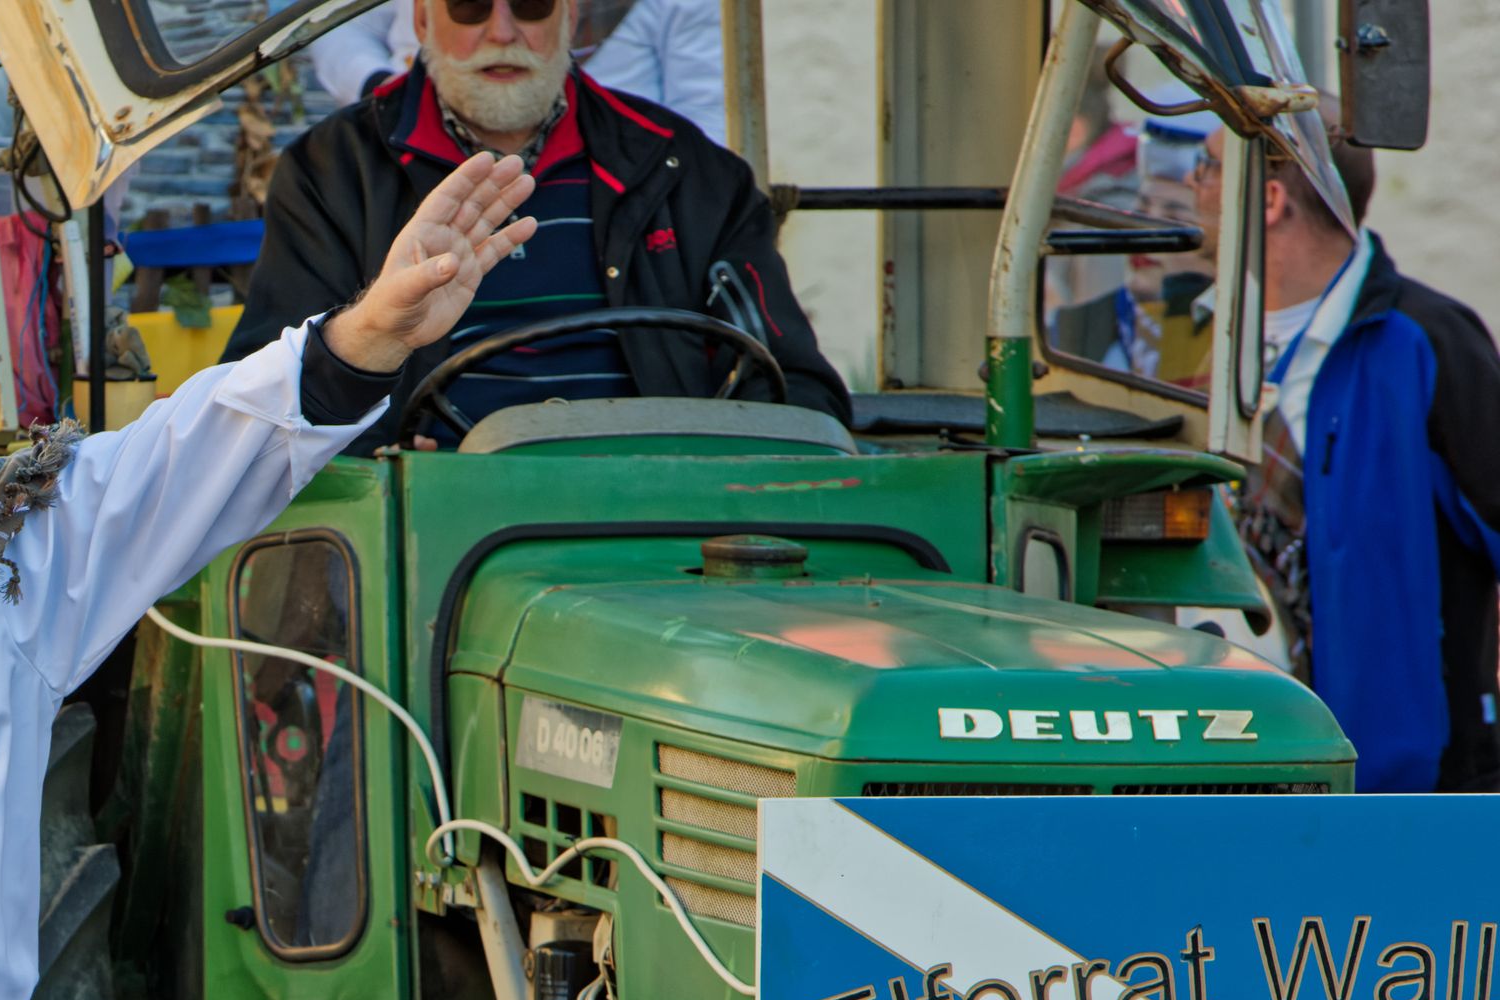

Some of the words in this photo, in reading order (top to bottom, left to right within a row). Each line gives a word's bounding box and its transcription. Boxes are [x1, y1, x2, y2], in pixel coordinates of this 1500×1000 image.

[537, 717, 550, 754] D
[552, 722, 604, 766] 4006
[938, 707, 1258, 741] DEUTZ
